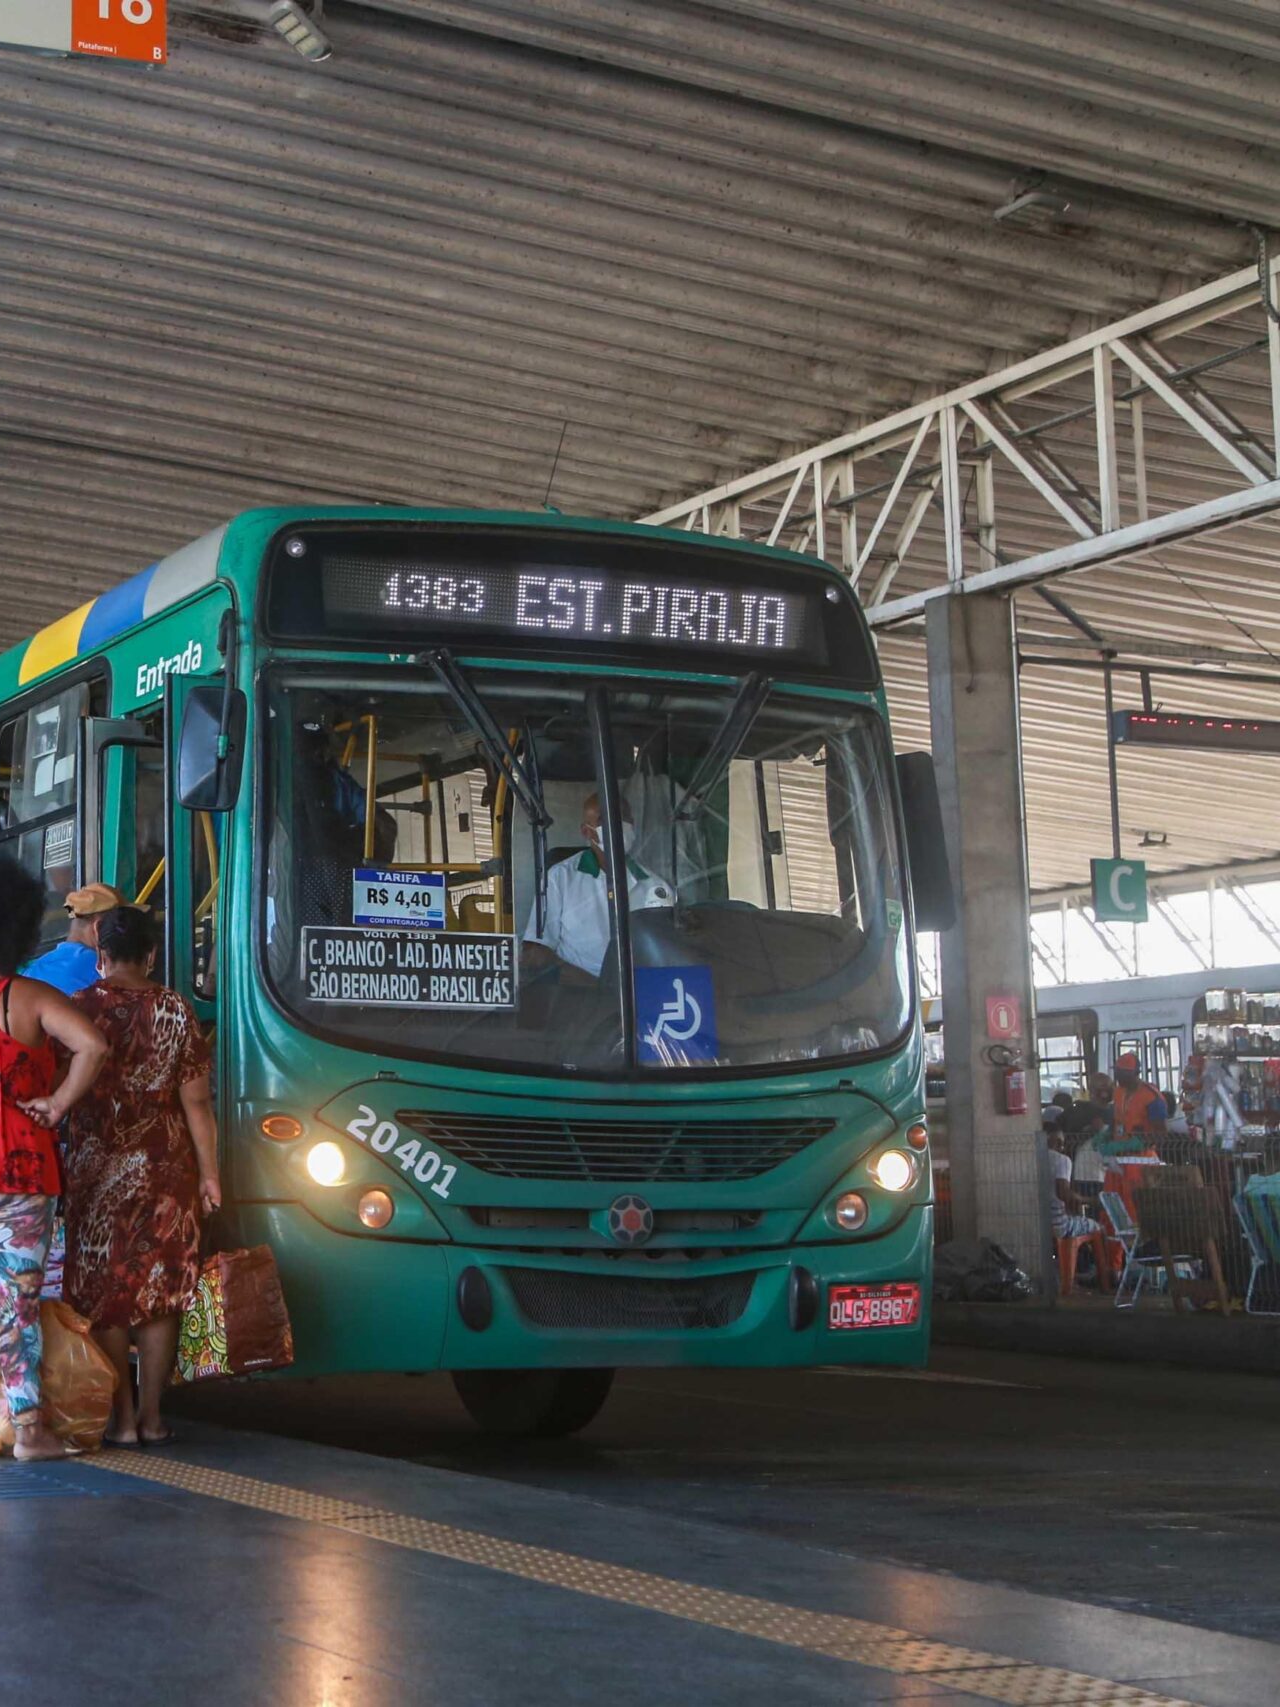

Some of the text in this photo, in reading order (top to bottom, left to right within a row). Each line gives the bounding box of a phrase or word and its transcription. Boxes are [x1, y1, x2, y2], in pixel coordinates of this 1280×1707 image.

[78, 41, 113, 53] Plataforma
[153, 47, 162, 60] B
[385, 573, 484, 612] 1383
[136, 639, 202, 697] Entrada
[376, 872, 421, 884] TARIFA
[1109, 865, 1136, 911] C
[367, 887, 389, 906] R$
[395, 890, 432, 908] 4,40
[363, 931, 400, 939] VOLTA
[386, 918, 430, 927] INTEGRAÇÃO
[309, 938, 322, 965] C.
[325, 939, 386, 967] BRANCO
[396, 941, 429, 969] LAD.
[432, 943, 453, 969] DA
[455, 940, 510, 971] NESTLÊ
[309, 965, 338, 998] SÃO
[341, 972, 420, 1000] BERNARDO
[430, 975, 480, 1002] BRASIL
[482, 971, 510, 1003] GÁS
[346, 1104, 457, 1199] 20401
